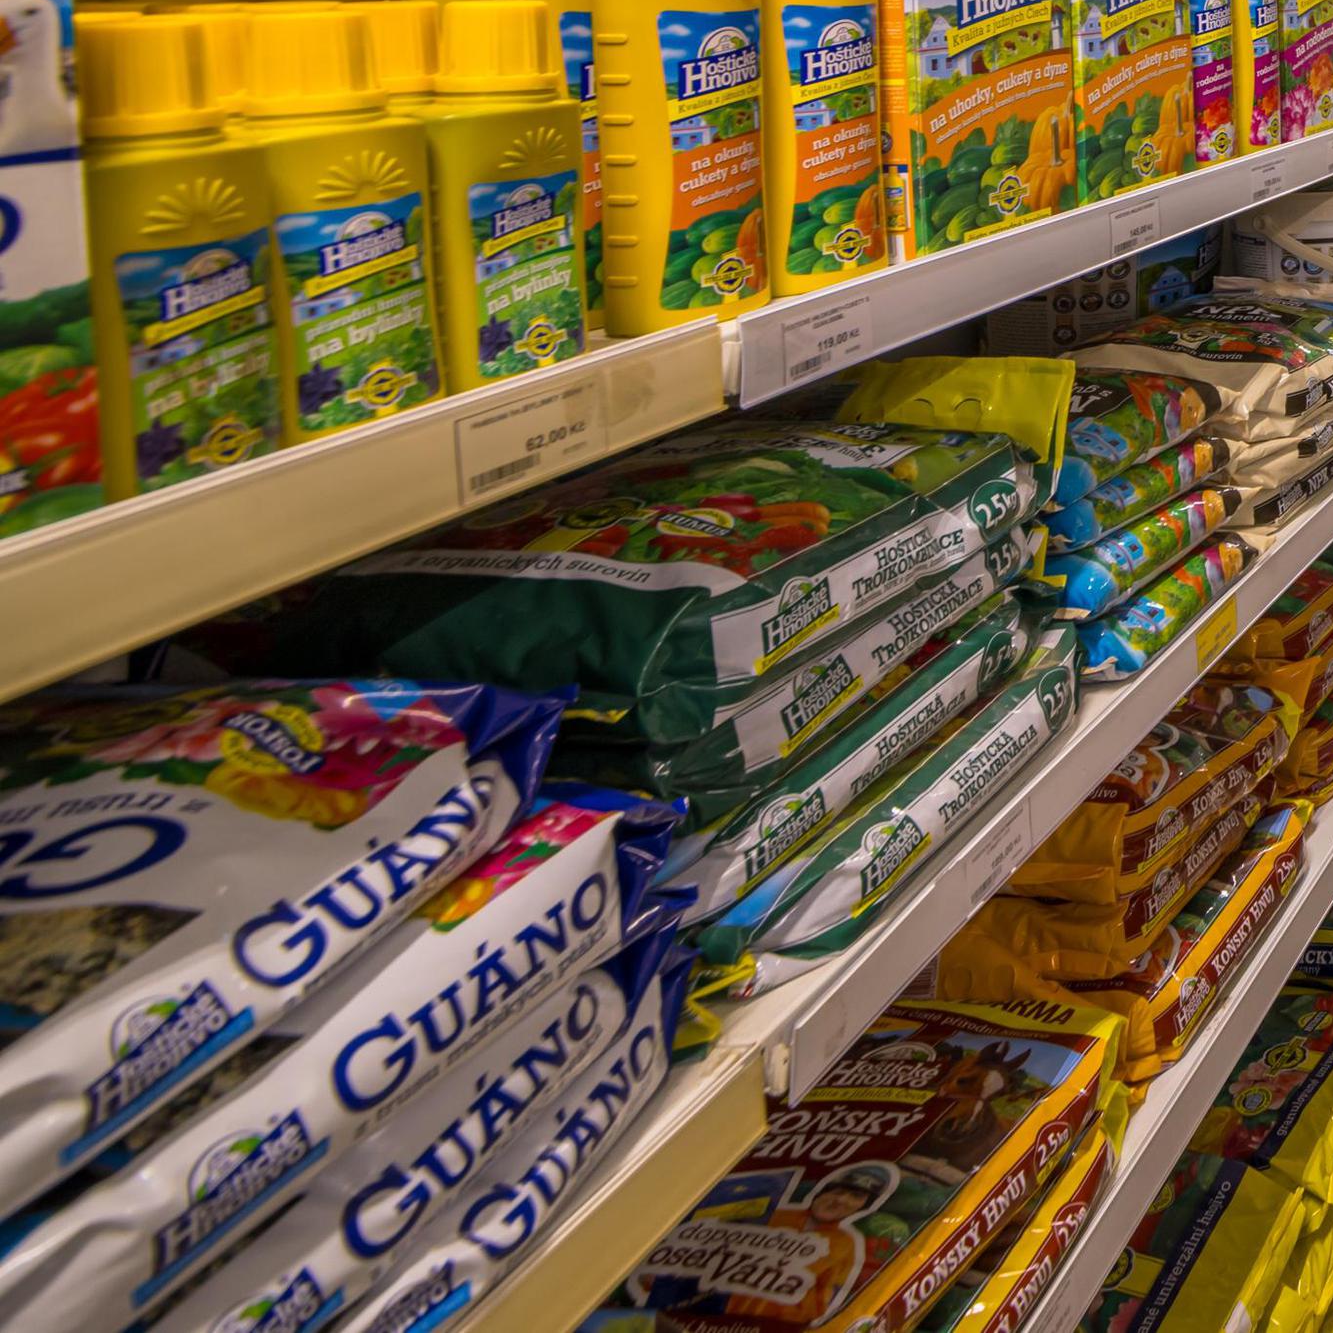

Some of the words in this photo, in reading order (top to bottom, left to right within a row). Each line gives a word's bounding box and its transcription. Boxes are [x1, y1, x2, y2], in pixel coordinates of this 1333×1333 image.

[1295, 44, 1304, 59] na
[930, 113, 946, 133] na
[948, 85, 995, 121] uhorky,
[996, 67, 1033, 94] cukety
[1034, 67, 1042, 78] a
[802, 147, 847, 169] cukety
[848, 144, 856, 156] a
[812, 133, 830, 151] na
[679, 170, 728, 194] cukety
[730, 169, 738, 180] a
[691, 156, 711, 173] na
[487, 294, 511, 316] na
[512, 269, 573, 305] bylinky
[308, 336, 343, 363] na
[659, 511, 733, 538] HUMUS
[1211, 916, 1253, 977] KOŇSKÝ
[333, 870, 608, 1113] GUÁNO
[341, 985, 600, 1259] GUÁNO
[1200, 1179, 1232, 1235] hnojivo
[676, 1220, 818, 1258] doporučuje
[903, 1221, 983, 1319] KOŇSKÝ
